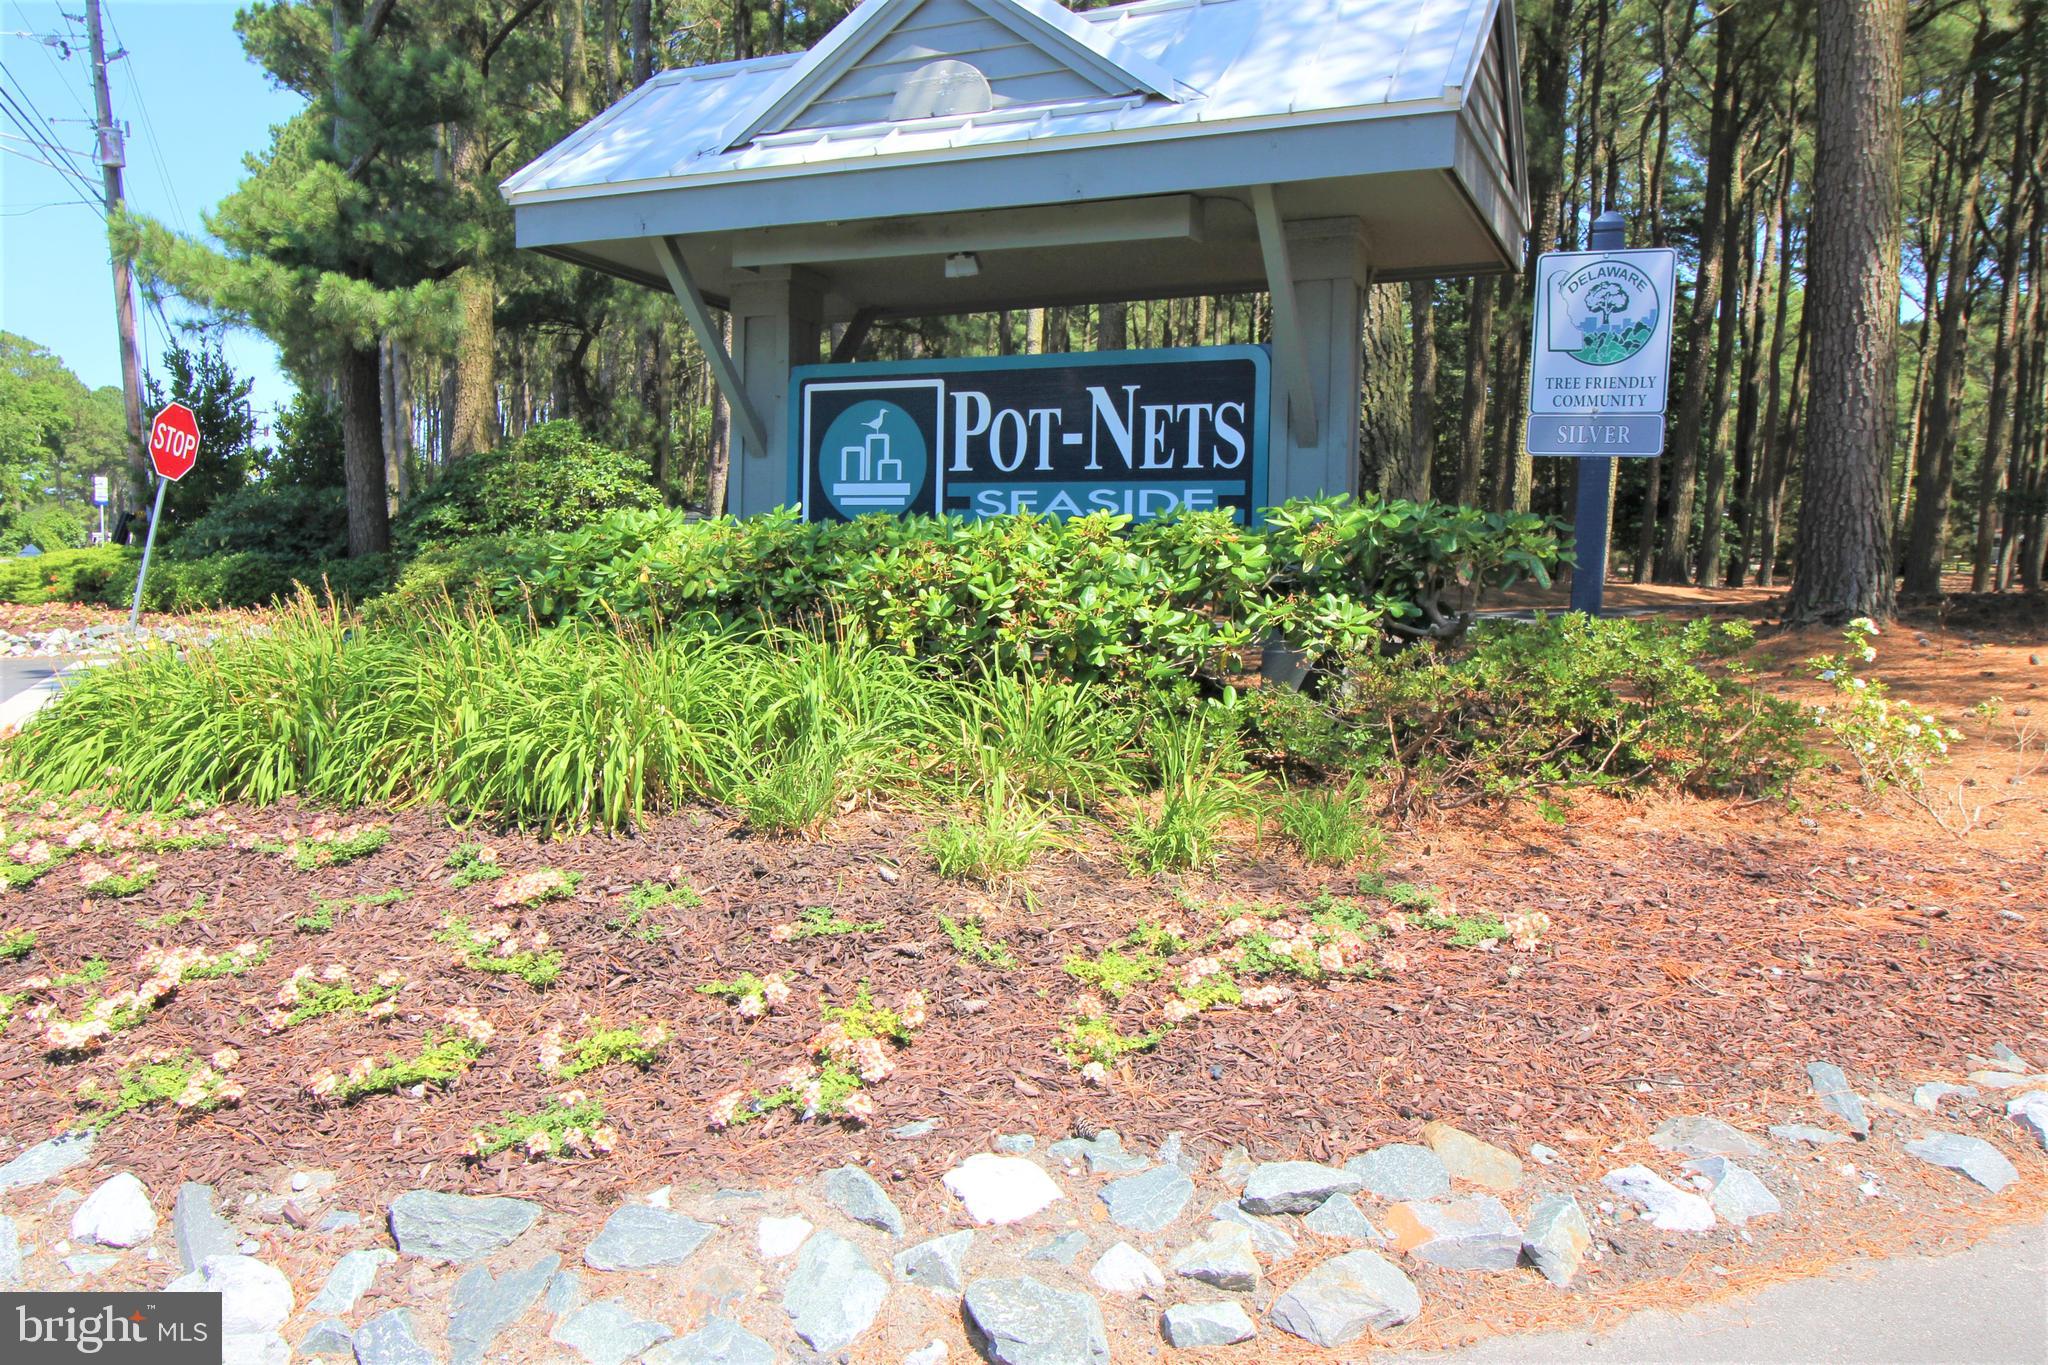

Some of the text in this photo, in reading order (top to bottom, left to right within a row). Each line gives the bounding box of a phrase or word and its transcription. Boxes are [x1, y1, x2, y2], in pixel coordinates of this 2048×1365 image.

[1568, 266, 1648, 294] DELAWARE
[1545, 376, 1657, 390] TREE FRIENDLY
[1552, 394, 1647, 408] COMMUNITY
[154, 422, 196, 459] STOP
[1557, 425, 1630, 444] SILVER
[975, 488, 1214, 517] SEASIDE
